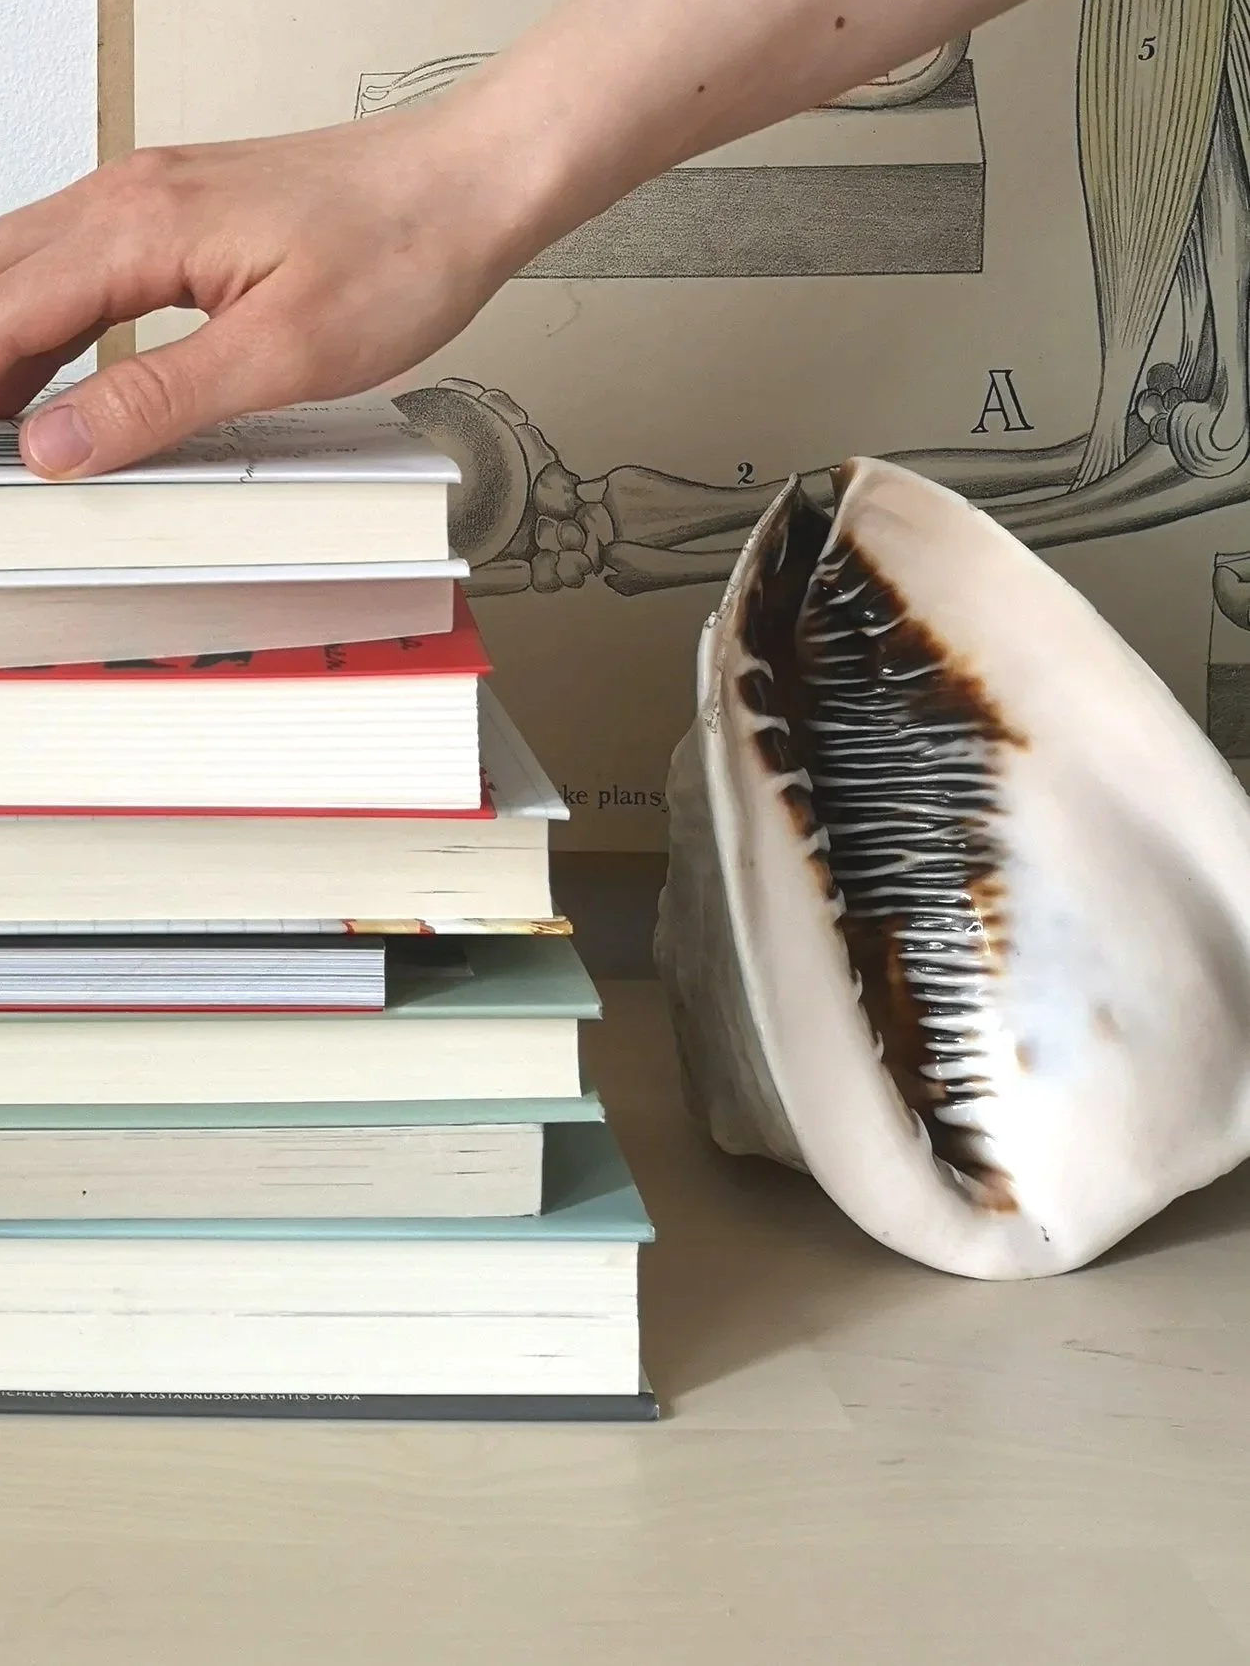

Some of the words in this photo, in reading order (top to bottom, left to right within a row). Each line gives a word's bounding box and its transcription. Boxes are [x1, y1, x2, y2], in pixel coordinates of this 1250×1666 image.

[1137, 35, 1157, 61] 5
[970, 369, 1035, 434] A
[737, 462, 755, 485] 2
[558, 784, 589, 805] ke
